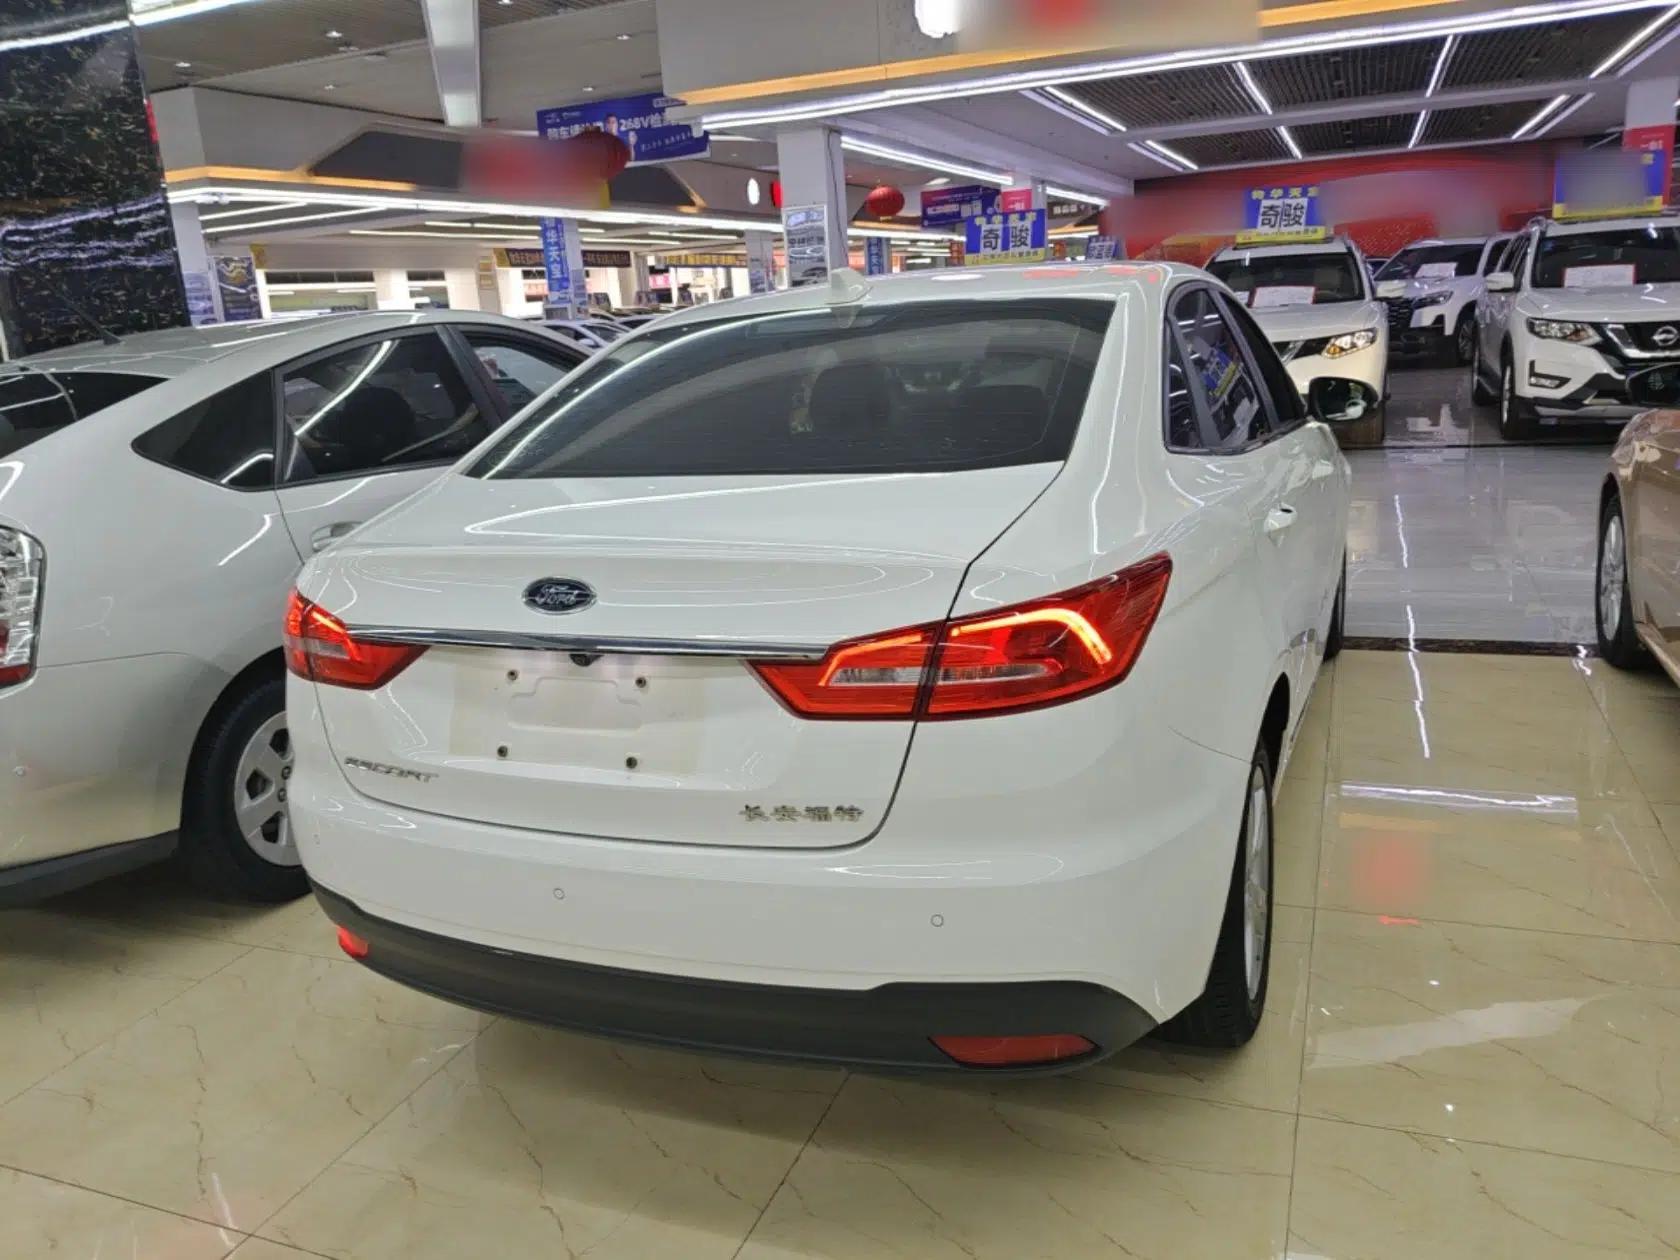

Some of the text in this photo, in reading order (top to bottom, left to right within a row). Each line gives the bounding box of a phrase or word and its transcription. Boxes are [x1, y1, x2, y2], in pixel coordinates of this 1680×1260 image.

[1261, 203, 1305, 229] 奇骏
[982, 224, 1029, 250] 奇骏
[536, 584, 579, 606] Ford
[738, 804, 864, 822] 长安福特
